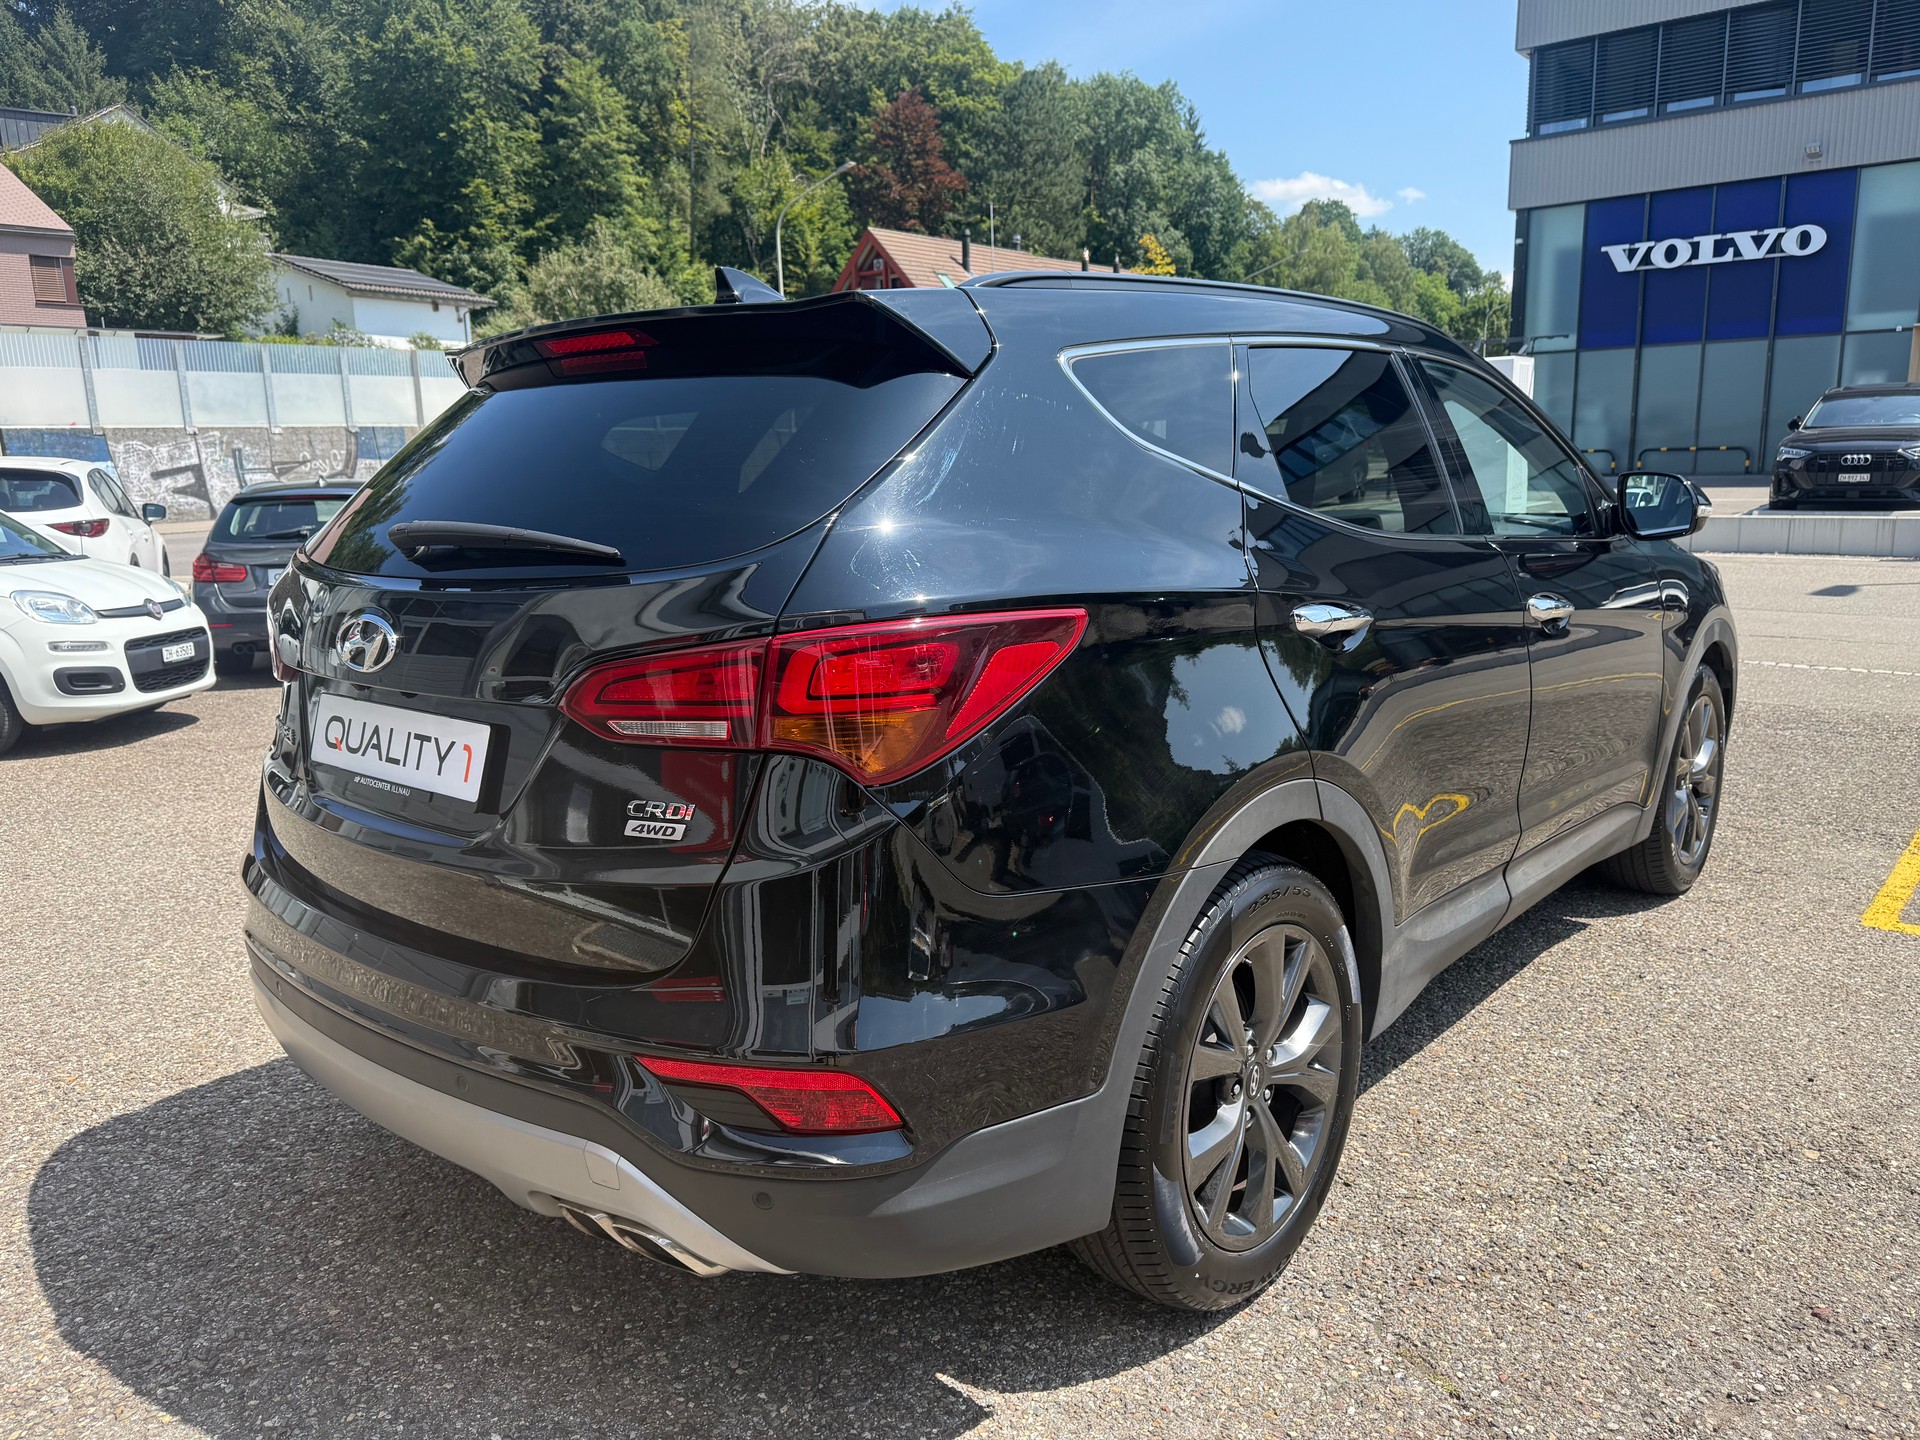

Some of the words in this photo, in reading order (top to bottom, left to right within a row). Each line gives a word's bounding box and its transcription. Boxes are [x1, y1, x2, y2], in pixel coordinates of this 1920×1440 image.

[1601, 224, 1827, 272] VOLVO
[360, 777, 391, 791] AUTOCENTER
[391, 784, 411, 796] ILLNAU
[631, 823, 677, 837] 4WD
